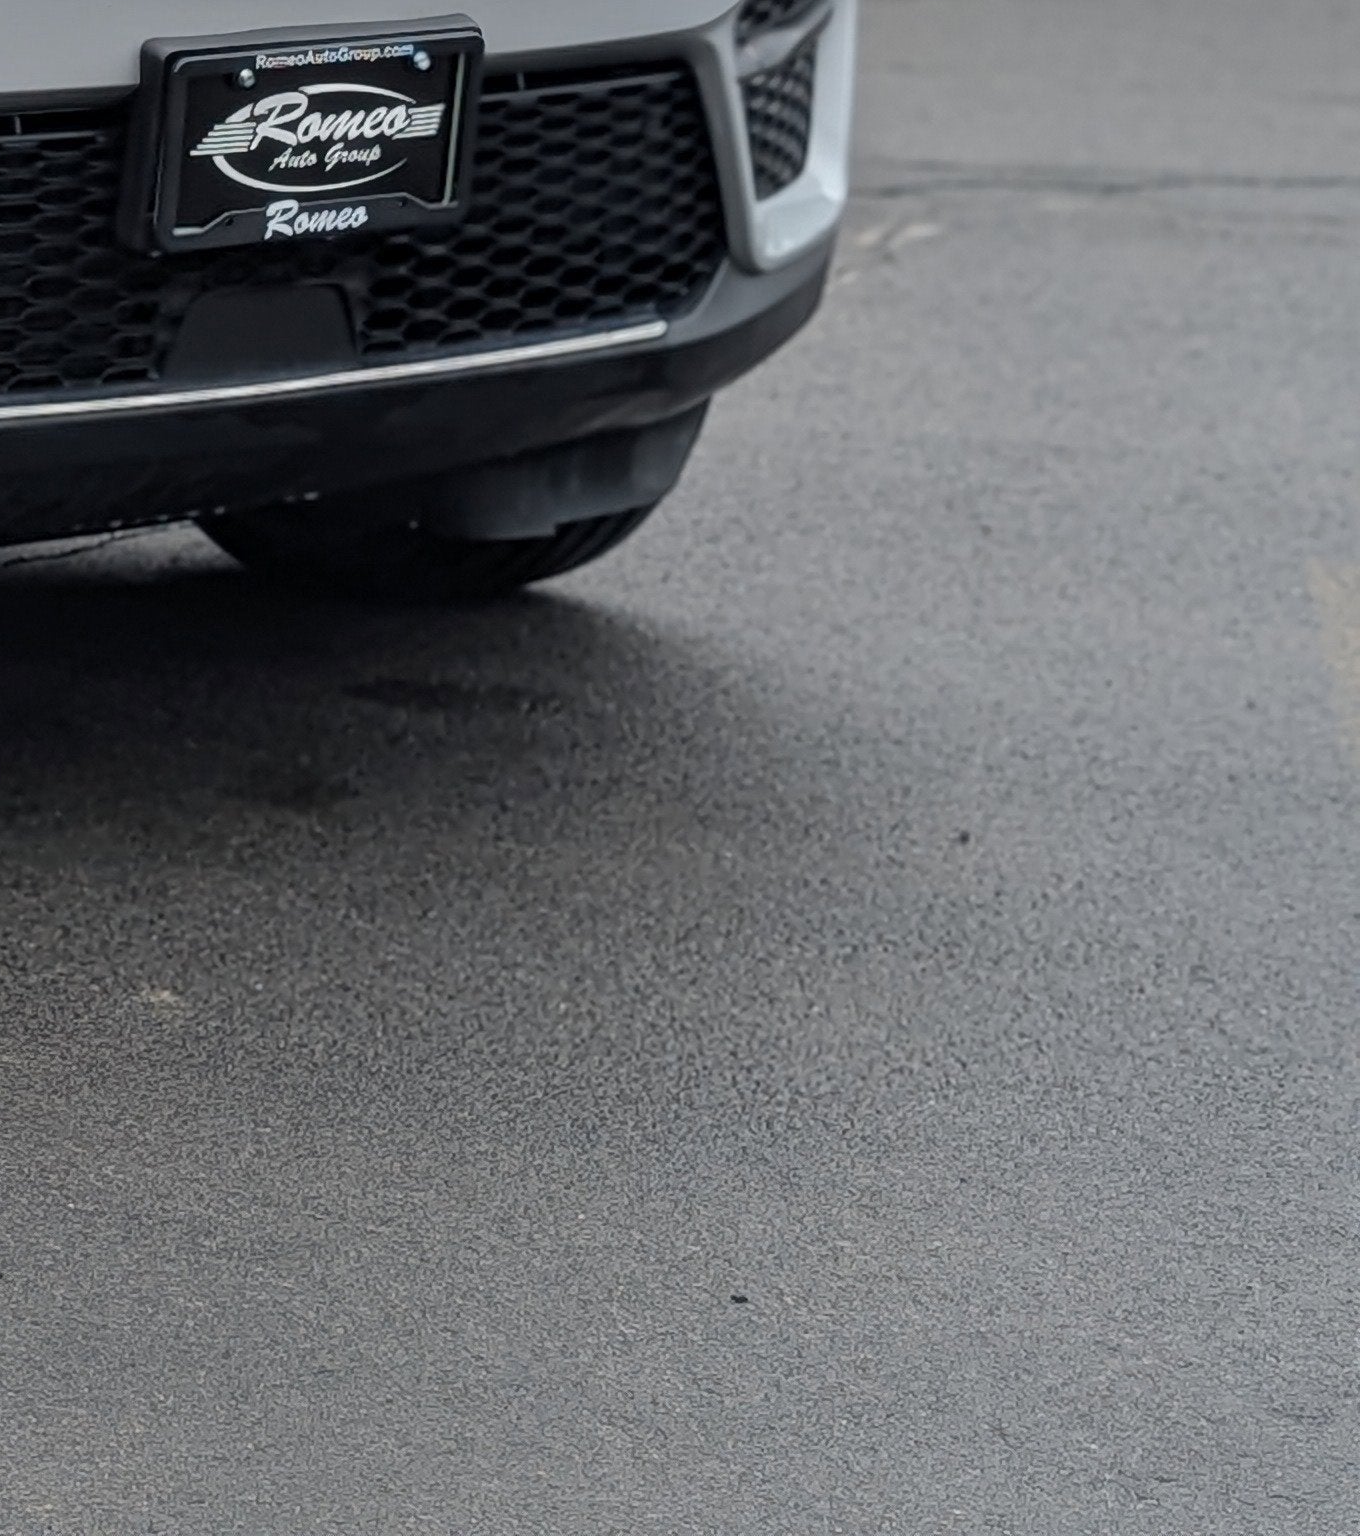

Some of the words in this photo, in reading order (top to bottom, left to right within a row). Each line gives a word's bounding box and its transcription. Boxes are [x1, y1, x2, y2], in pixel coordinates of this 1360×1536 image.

[254, 43, 415, 70] RomeoAutoGroup.com
[248, 90, 411, 151] Romeo
[268, 147, 318, 172] Auto
[324, 142, 381, 172] Group
[263, 198, 369, 241] Romeo
